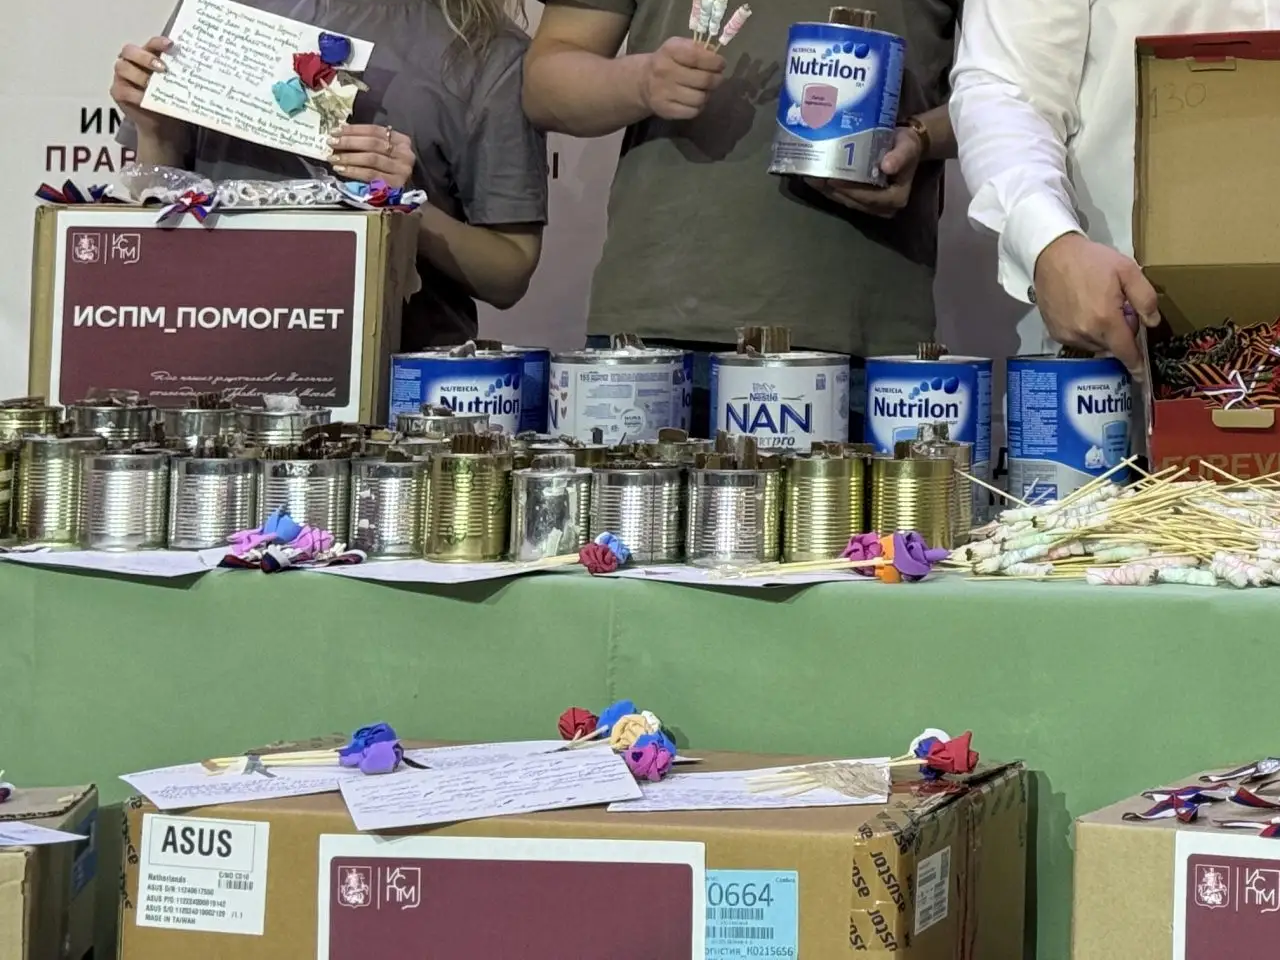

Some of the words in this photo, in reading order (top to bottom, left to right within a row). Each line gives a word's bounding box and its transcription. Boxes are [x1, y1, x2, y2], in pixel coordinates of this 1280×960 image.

[789, 56, 867, 82] Nutrilon
[1149, 82, 1207, 118] 130
[844, 142, 856, 166] 1
[73, 305, 345, 333] ИСПМ_ПОМОГАЕТ
[440, 395, 520, 415] Nutrilon
[725, 401, 813, 435] NAN
[874, 397, 959, 419] Nutrilon
[161, 825, 233, 858] ASUS
[707, 882, 775, 907] 0664
